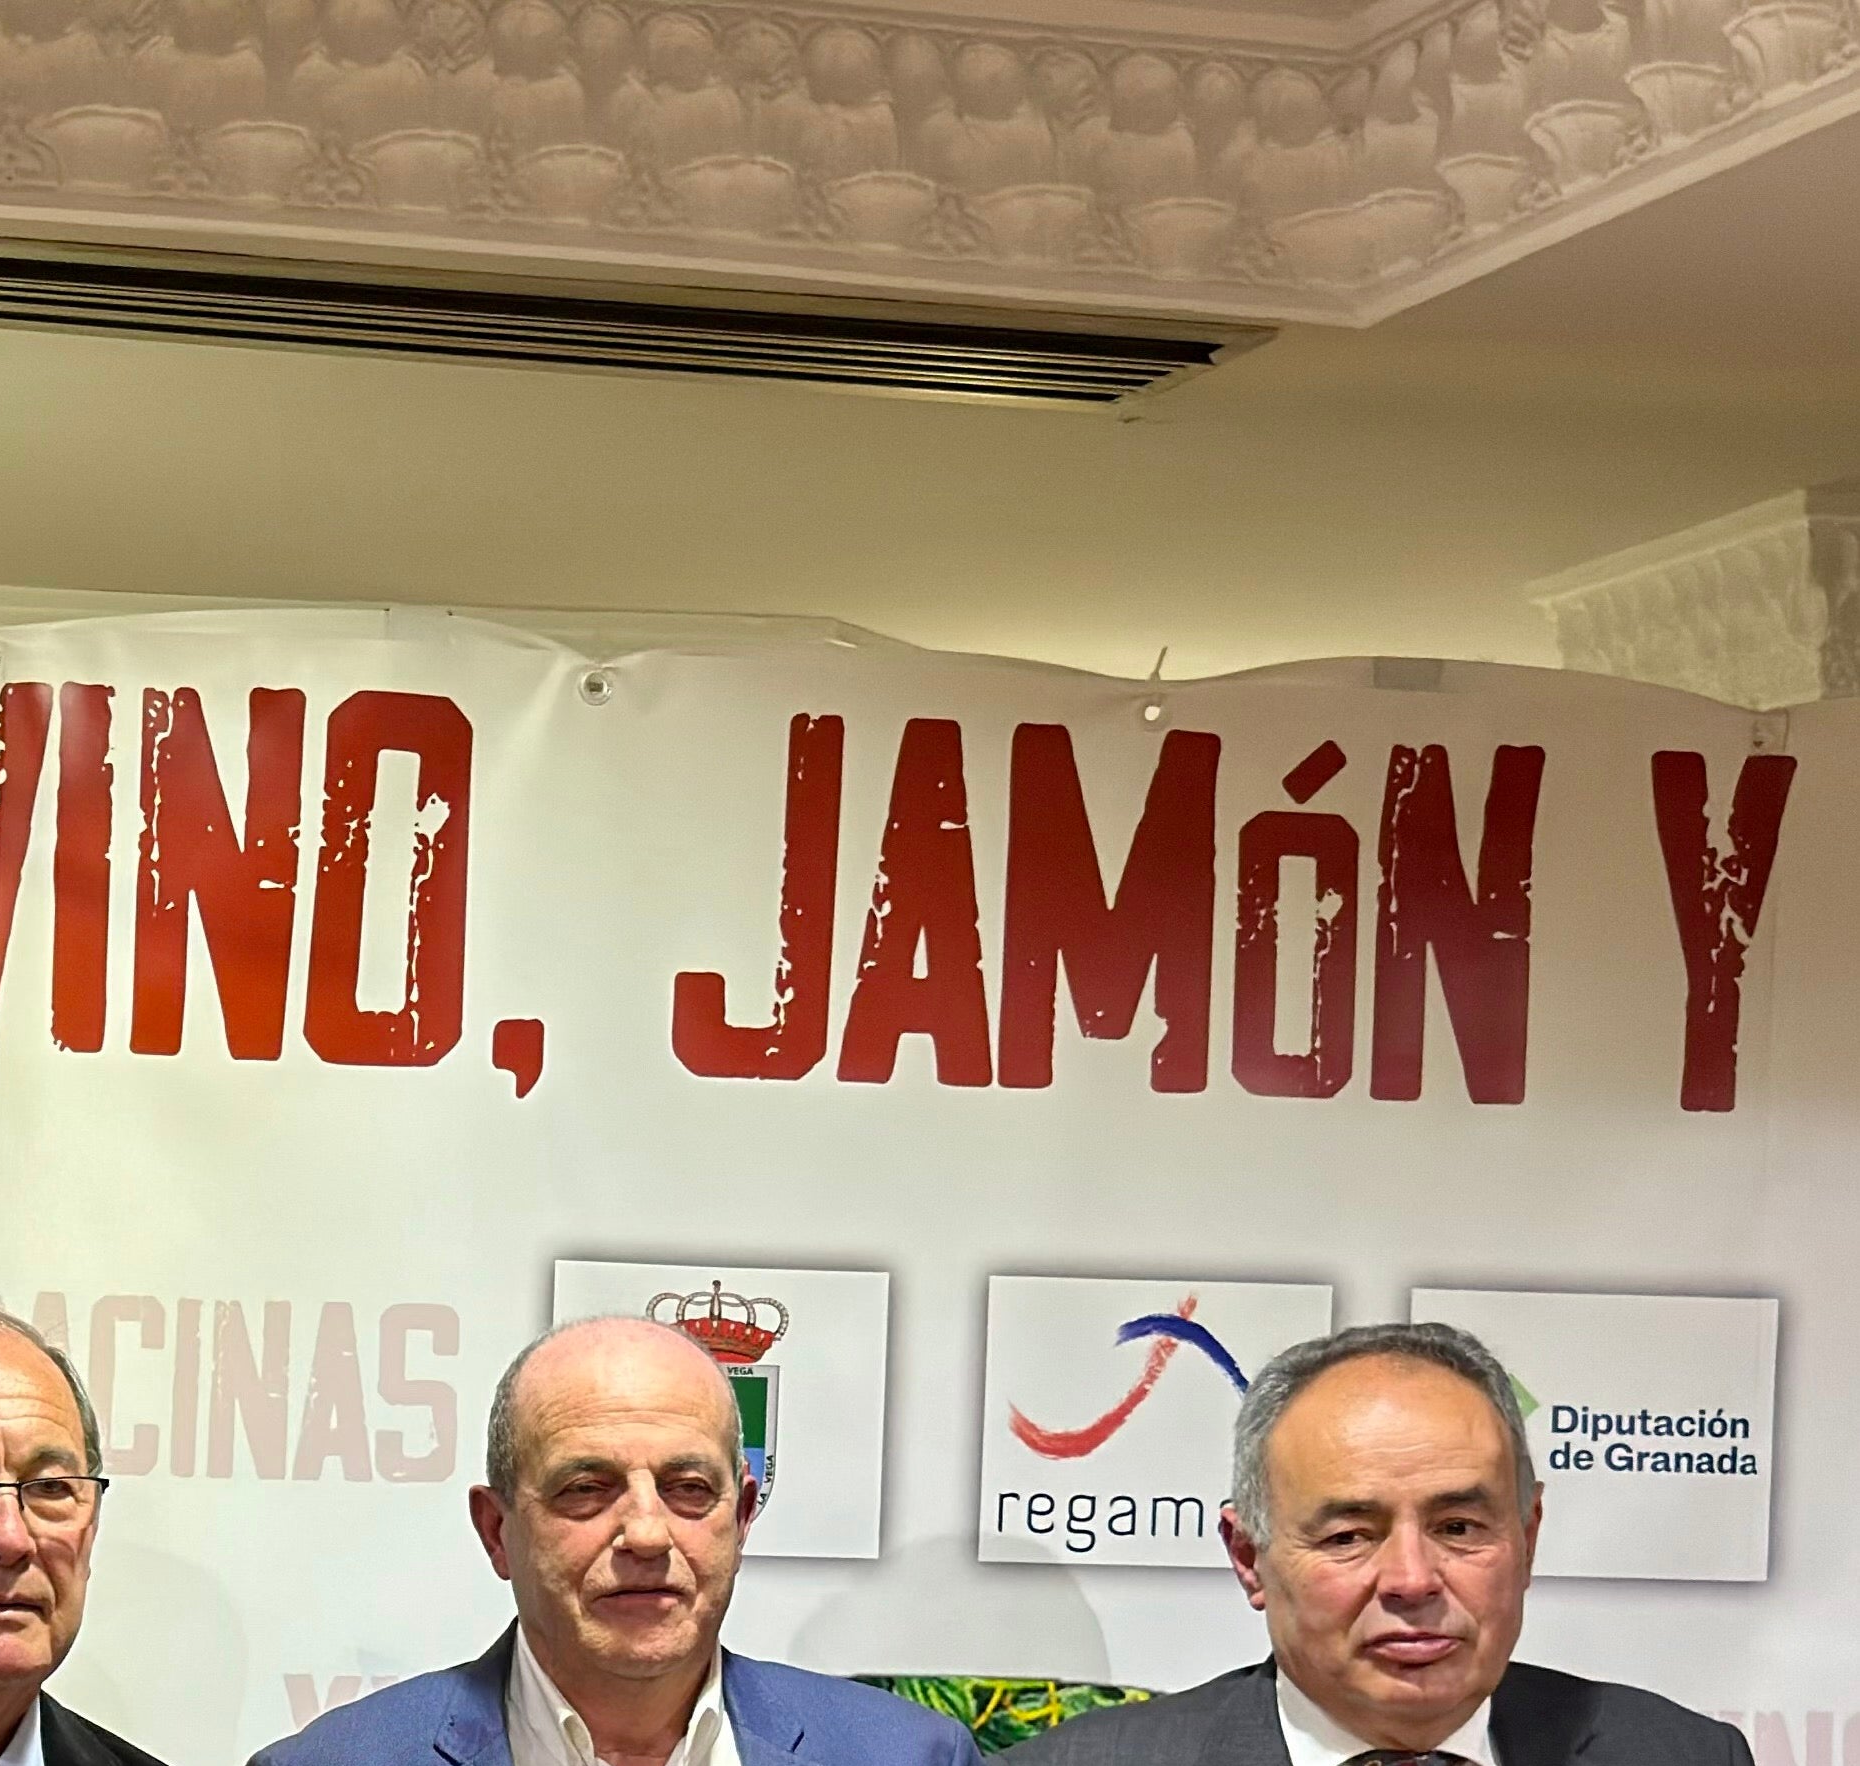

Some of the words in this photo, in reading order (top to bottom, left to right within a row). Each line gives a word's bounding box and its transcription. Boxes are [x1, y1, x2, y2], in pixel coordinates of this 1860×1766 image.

[672, 711, 1546, 1106] JAMÓN
[1652, 750, 1798, 1112] Y
[1549, 1403, 1750, 1447] Diputación
[1548, 1442, 1595, 1472] de
[1603, 1444, 1759, 1477] Granada
[996, 1488, 1234, 1555] regam
